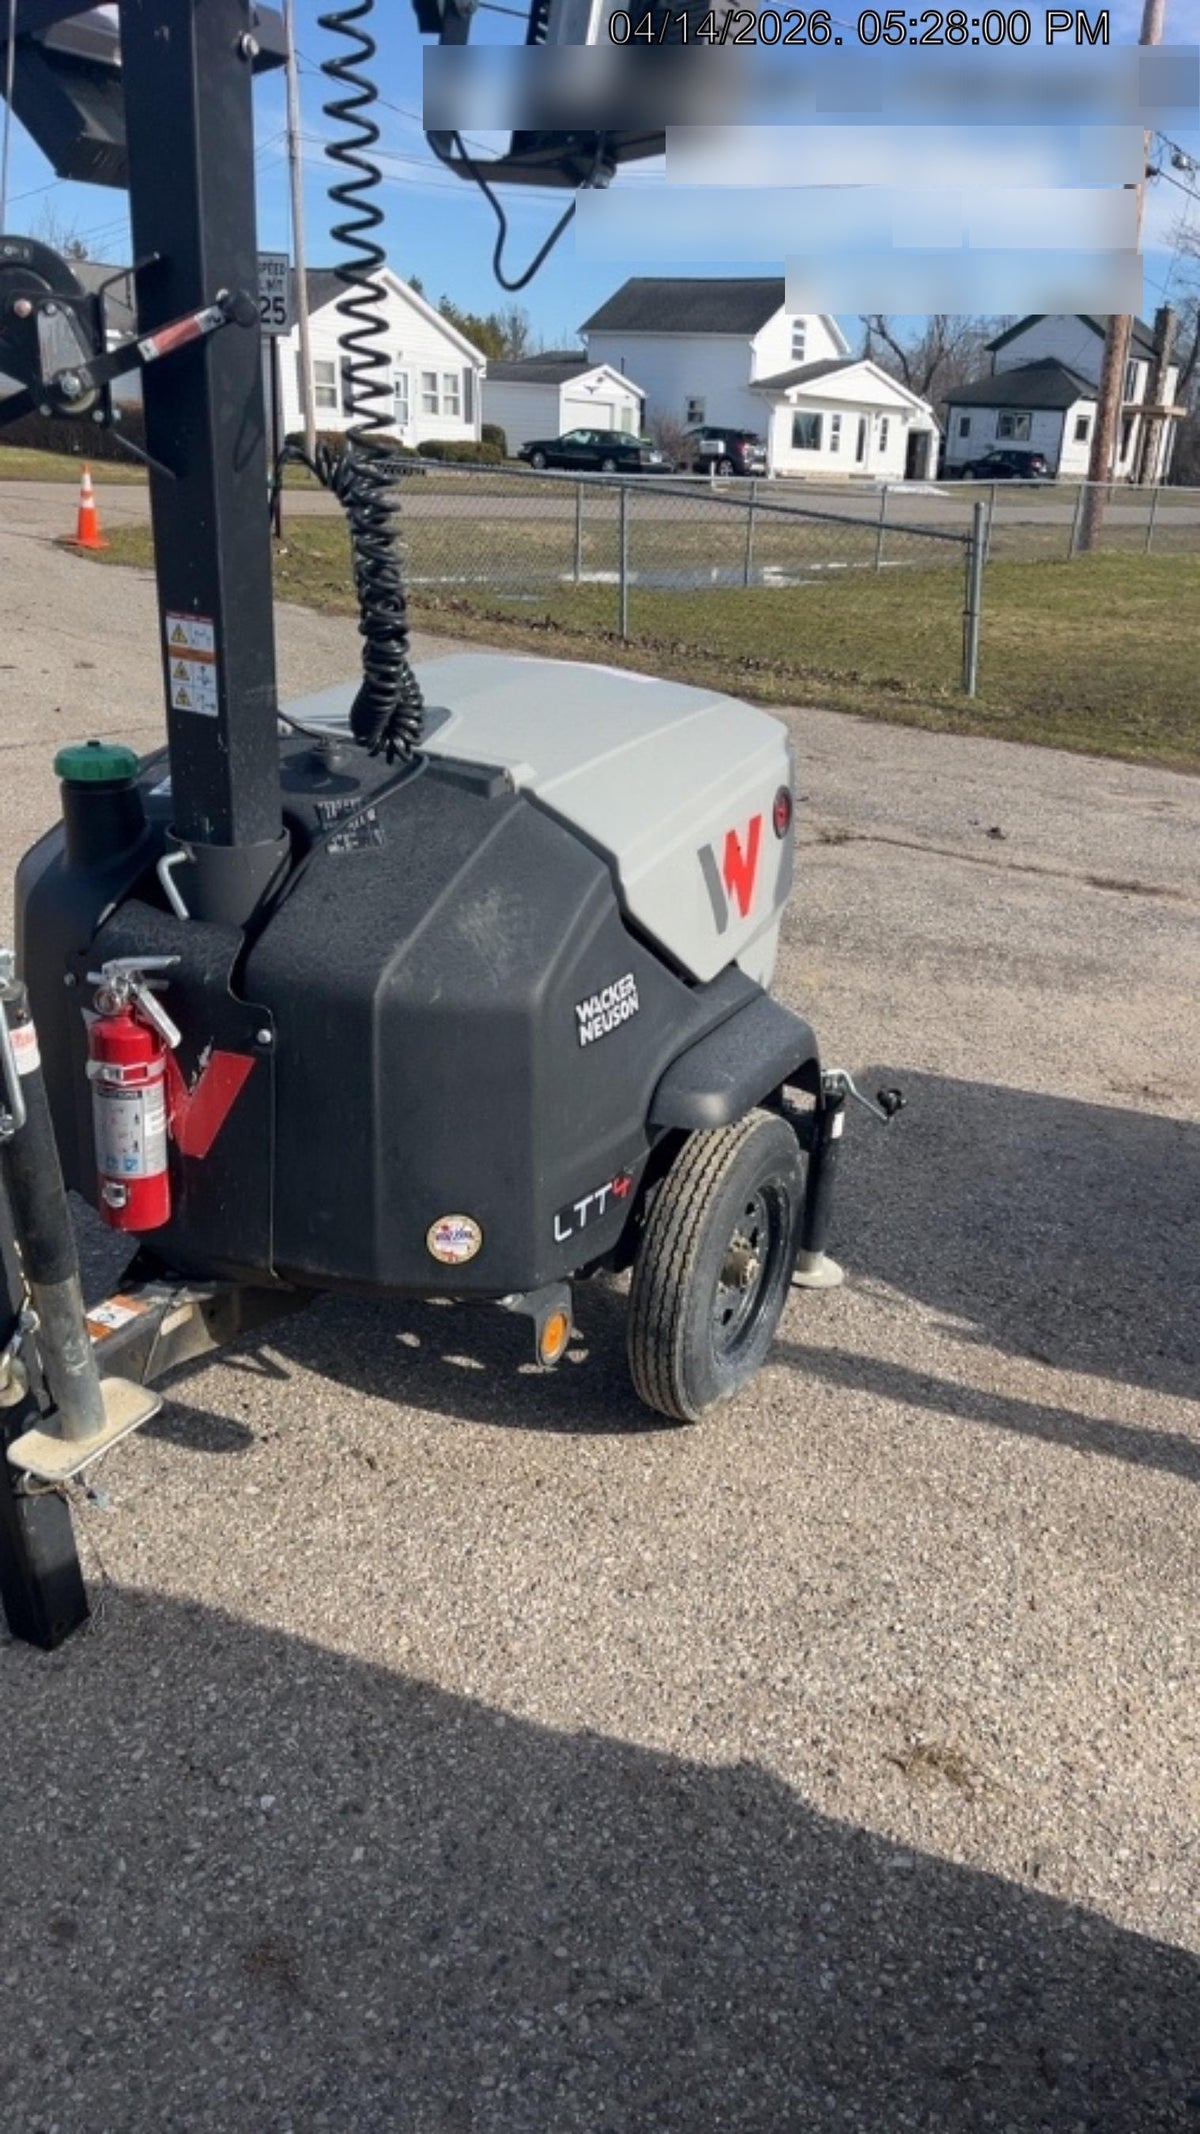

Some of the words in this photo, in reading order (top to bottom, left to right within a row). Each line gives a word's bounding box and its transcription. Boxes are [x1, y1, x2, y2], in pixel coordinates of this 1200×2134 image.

[259, 295, 286, 325] 25
[576, 972, 636, 1022] WACKER
[579, 993, 639, 1046] NEUSON
